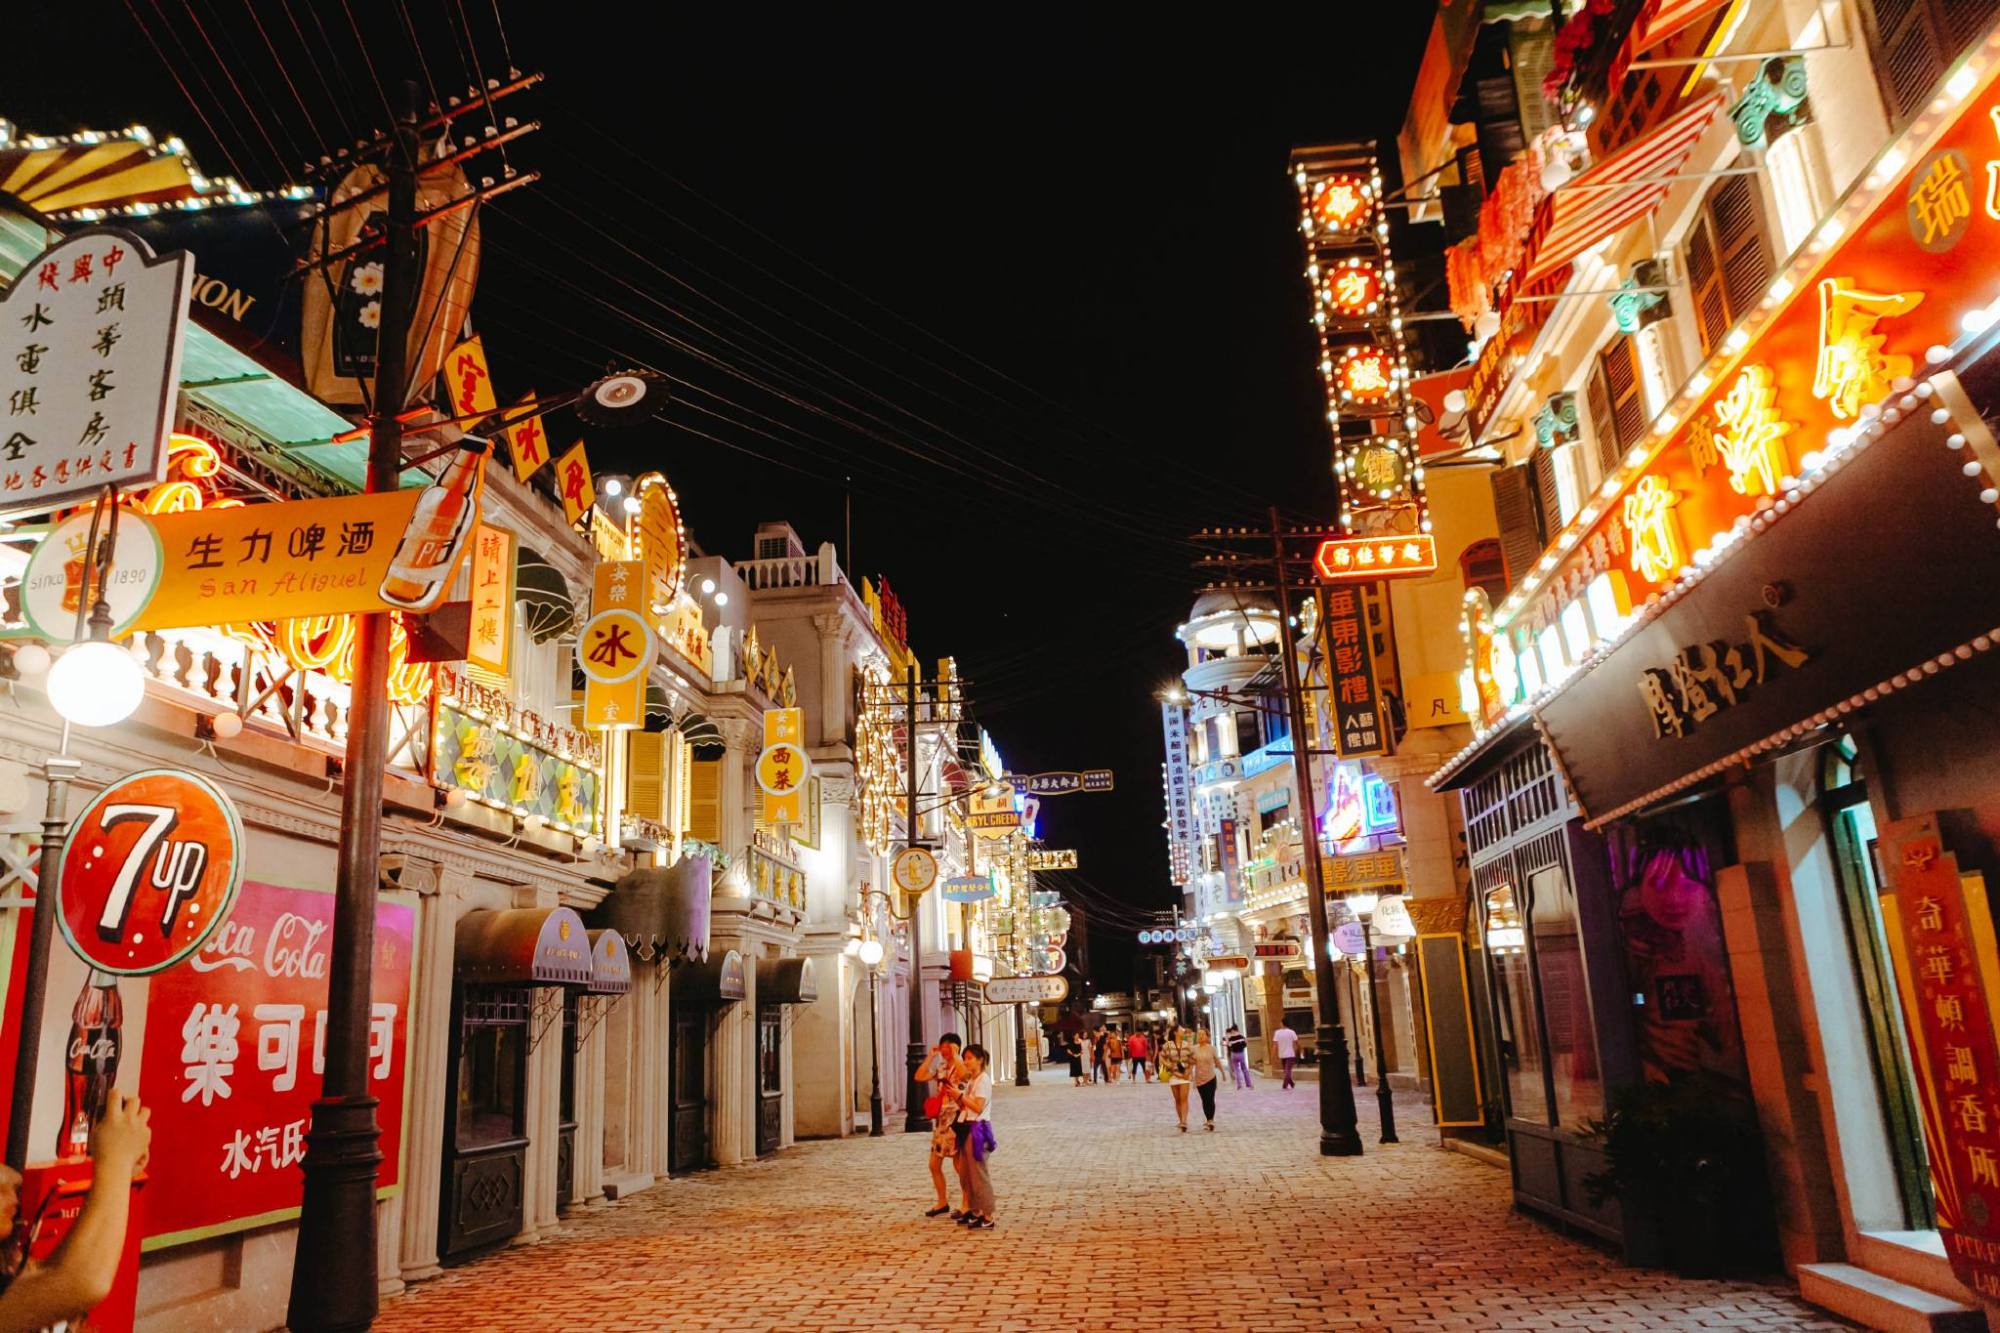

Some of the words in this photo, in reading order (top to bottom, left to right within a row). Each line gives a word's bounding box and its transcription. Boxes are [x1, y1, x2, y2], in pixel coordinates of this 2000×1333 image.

[186, 521, 374, 570] 生力啤酒
[114, 568, 147, 585] 1890
[200, 577, 258, 599] San
[588, 623, 638, 668] 冰
[263, 911, 329, 979] Cola
